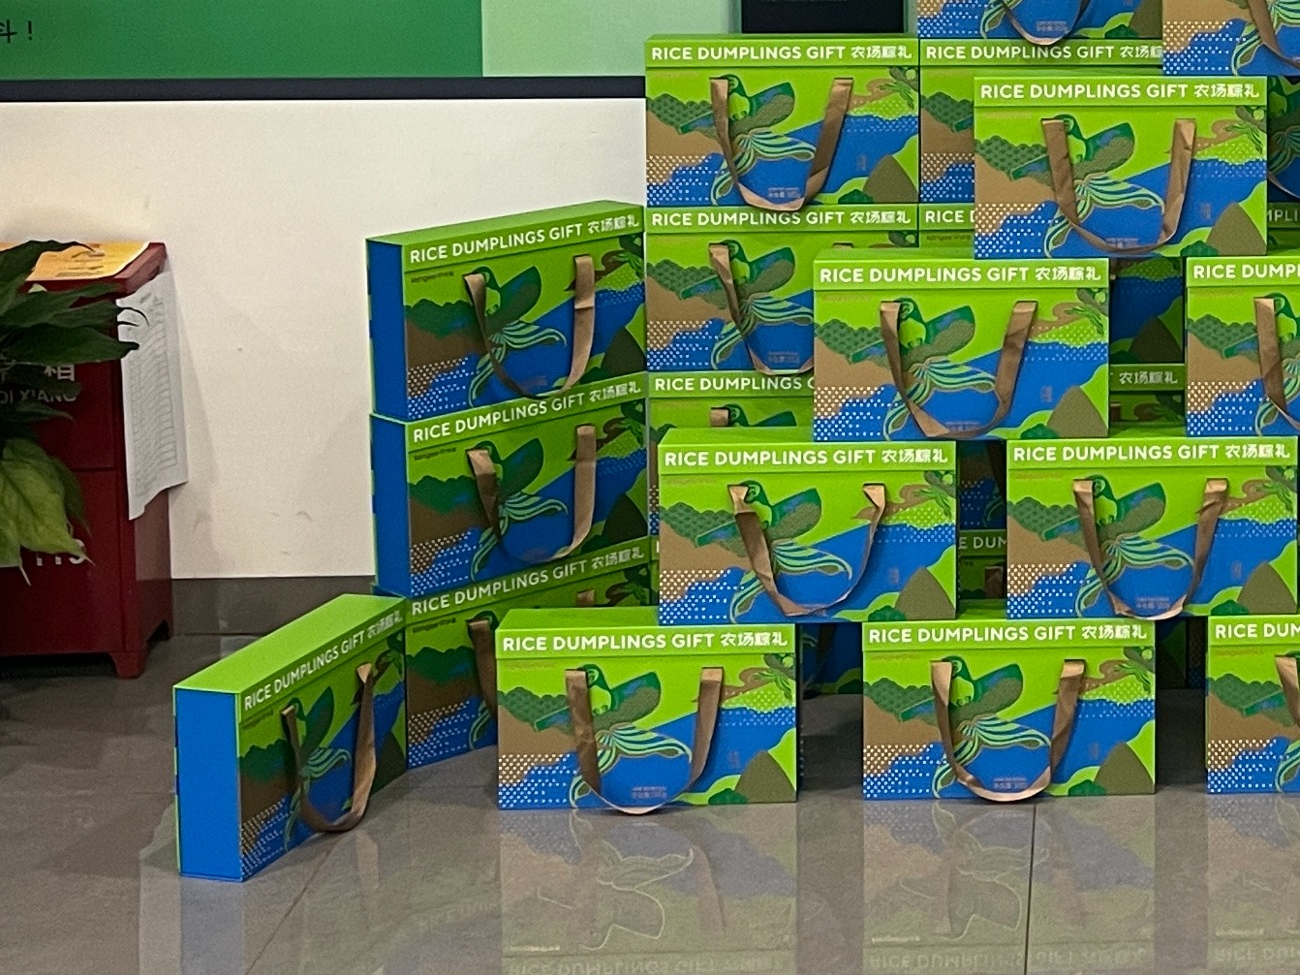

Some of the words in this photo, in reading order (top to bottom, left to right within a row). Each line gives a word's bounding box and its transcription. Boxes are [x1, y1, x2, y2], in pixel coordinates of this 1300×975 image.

[651, 46, 693, 61] RICE
[697, 46, 802, 60] DUMPLINGS
[806, 45, 846, 60] GIFT
[980, 84, 1025, 99] RICE
[1029, 83, 1141, 99] DUMPLINGS
[1146, 83, 1189, 99] GIFT
[409, 244, 448, 264] RICE
[452, 229, 546, 257] DUMPLINGS
[548, 223, 583, 241] GIFT
[1193, 264, 1236, 279] RICE
[664, 451, 709, 467] RICE
[714, 449, 828, 466] DUMPLINGS
[832, 449, 876, 465] GIFT
[1215, 623, 1258, 639] RICE
[502, 636, 547, 652] RICE
[552, 633, 667, 651] DUMPLINGS
[671, 632, 715, 649] GIFT
[243, 687, 272, 711] RICE
[273, 646, 340, 696] DUMPLINGS
[340, 629, 366, 656] GIFT
